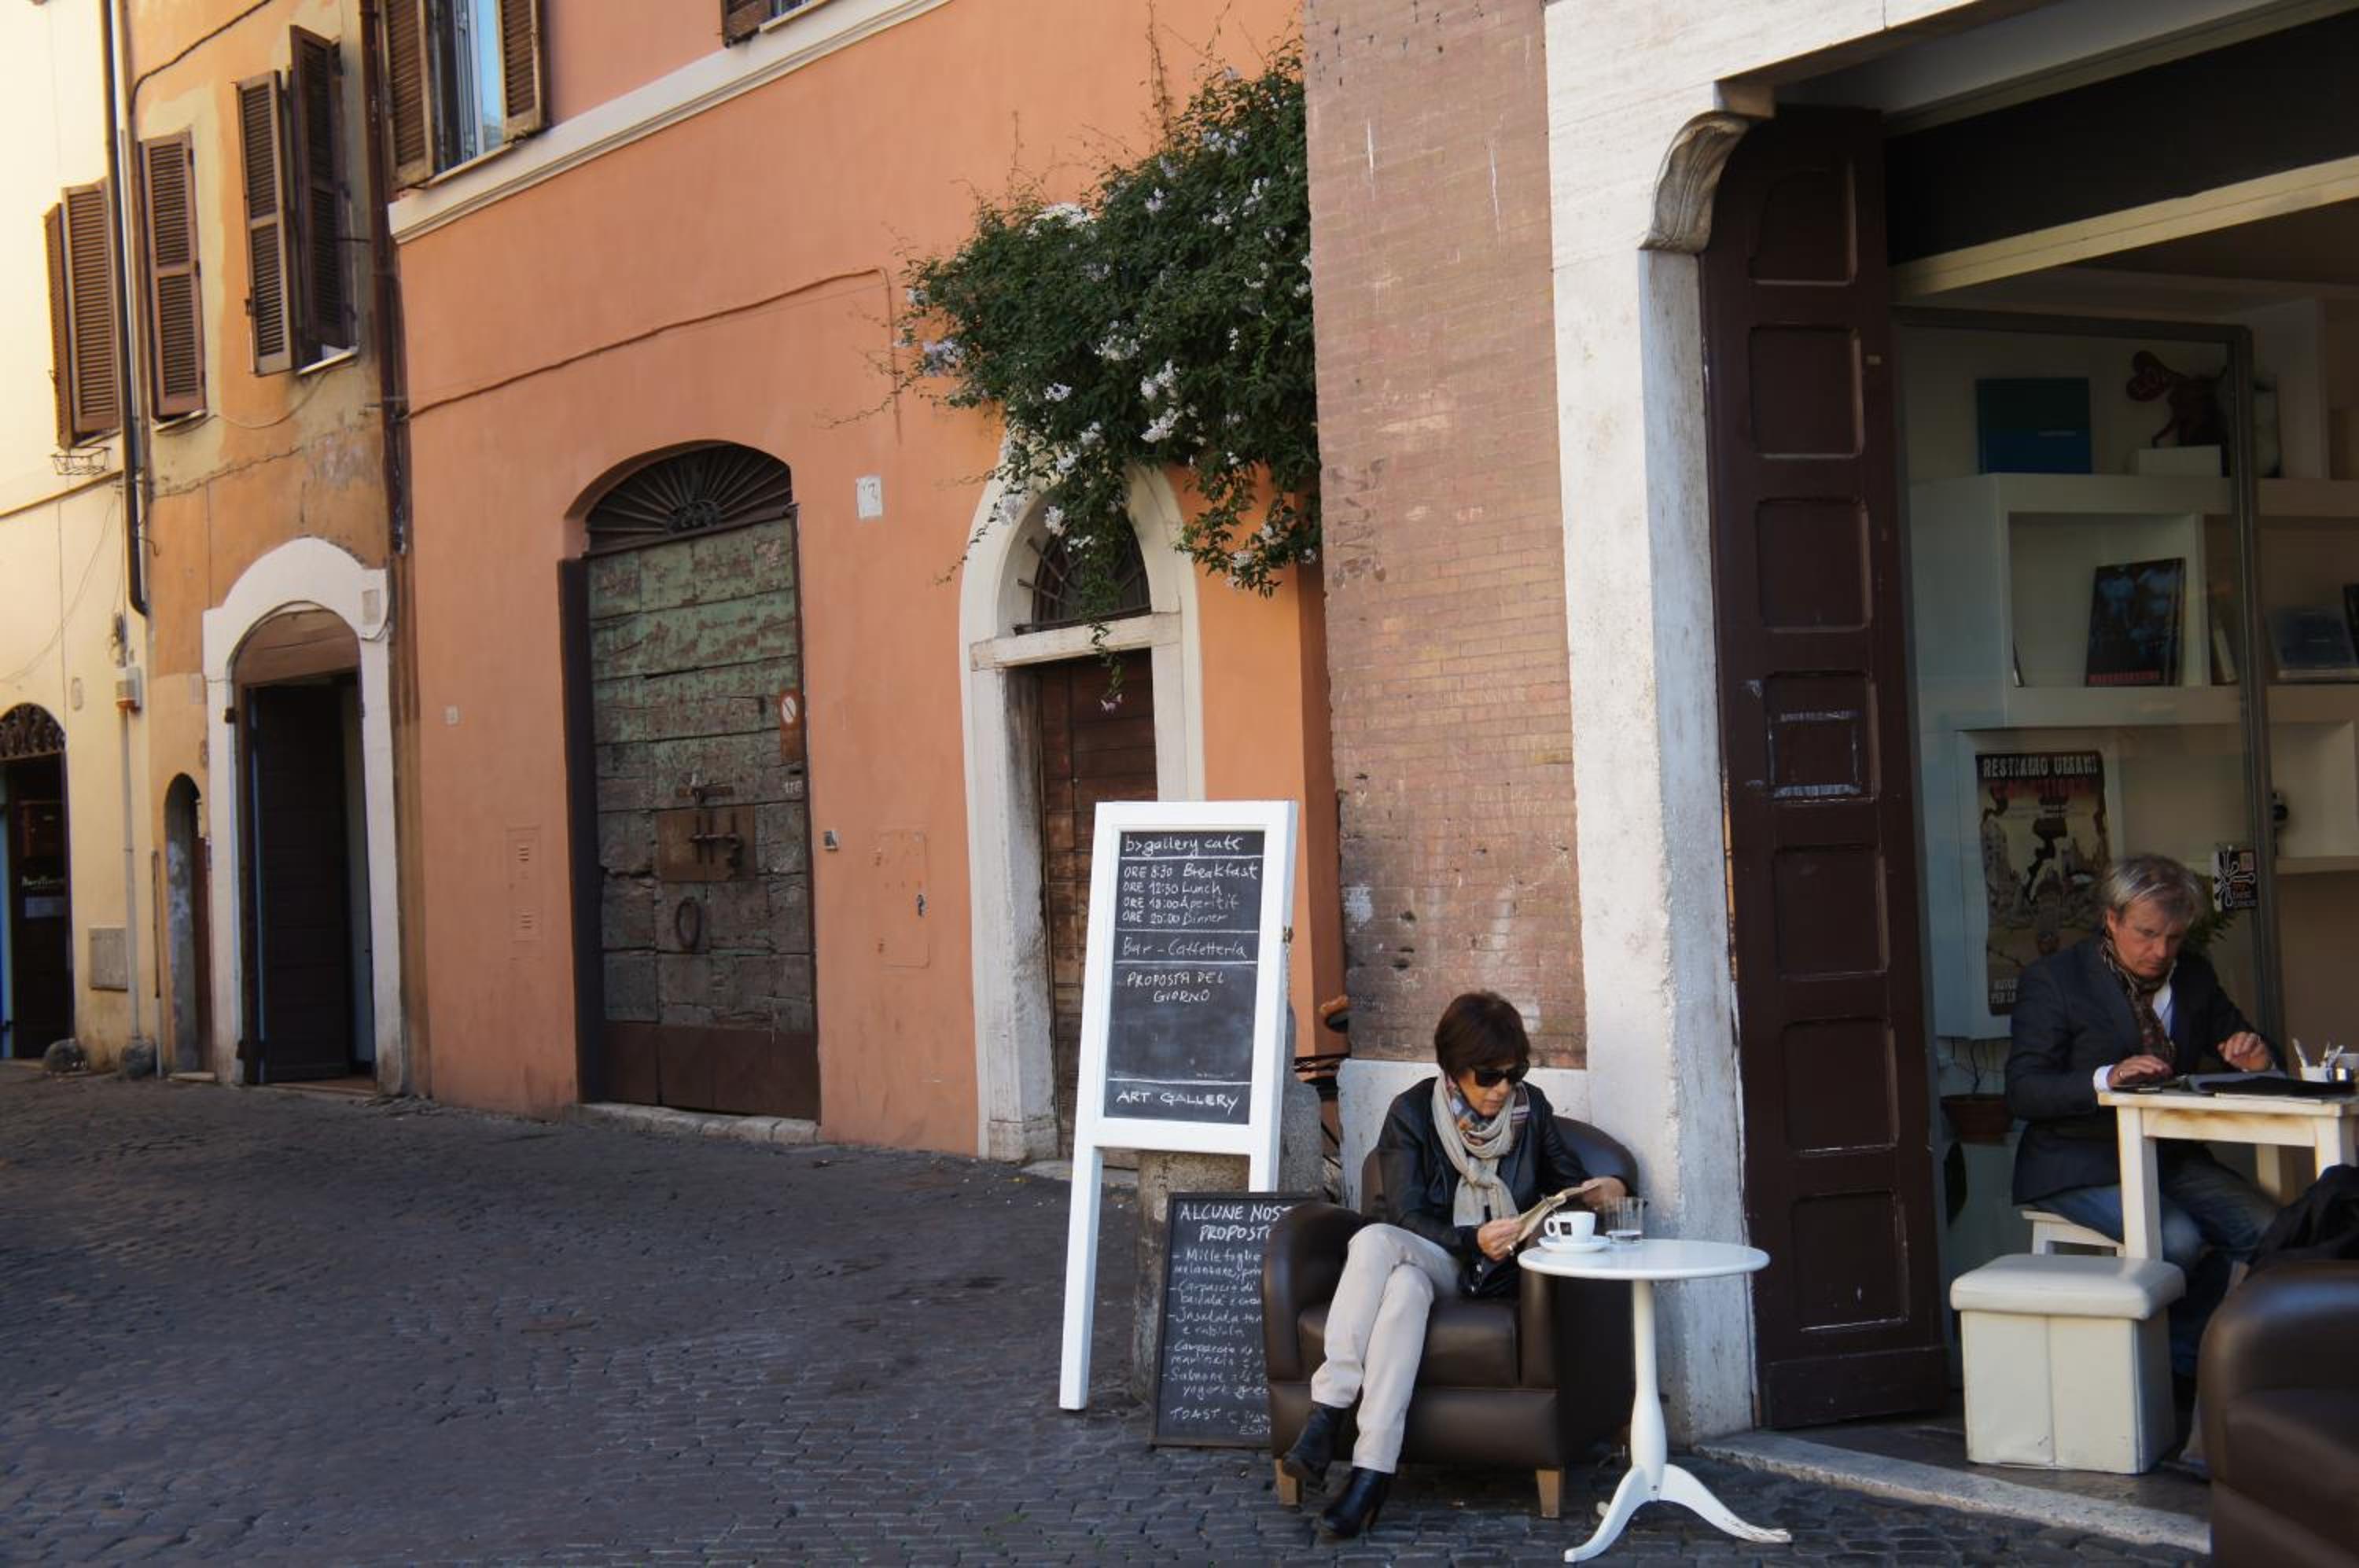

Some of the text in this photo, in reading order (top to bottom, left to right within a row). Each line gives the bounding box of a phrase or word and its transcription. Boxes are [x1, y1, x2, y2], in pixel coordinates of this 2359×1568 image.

[1982, 756, 2048, 778] RESTIAMO
[1124, 866, 1146, 878] ORE
[1183, 862, 1258, 880] Breakfast
[1122, 880, 1222, 895] ORE 12:30 Lunch
[1122, 896, 1145, 909] ORE
[1149, 897, 1178, 909] 18:00
[1122, 911, 1143, 923] ORE
[1181, 911, 1228, 926] Dinner
[1122, 936, 1151, 956] Bar
[1168, 938, 1247, 959] Caffetteria
[1127, 970, 1224, 987] PROPOSTA DEL
[1154, 988, 1210, 1003] GIORNO
[1116, 1091, 1239, 1115] ART GALLERY
[1180, 1203, 1244, 1221] ALCUNE
[1170, 1406, 1221, 1420] TOAST
